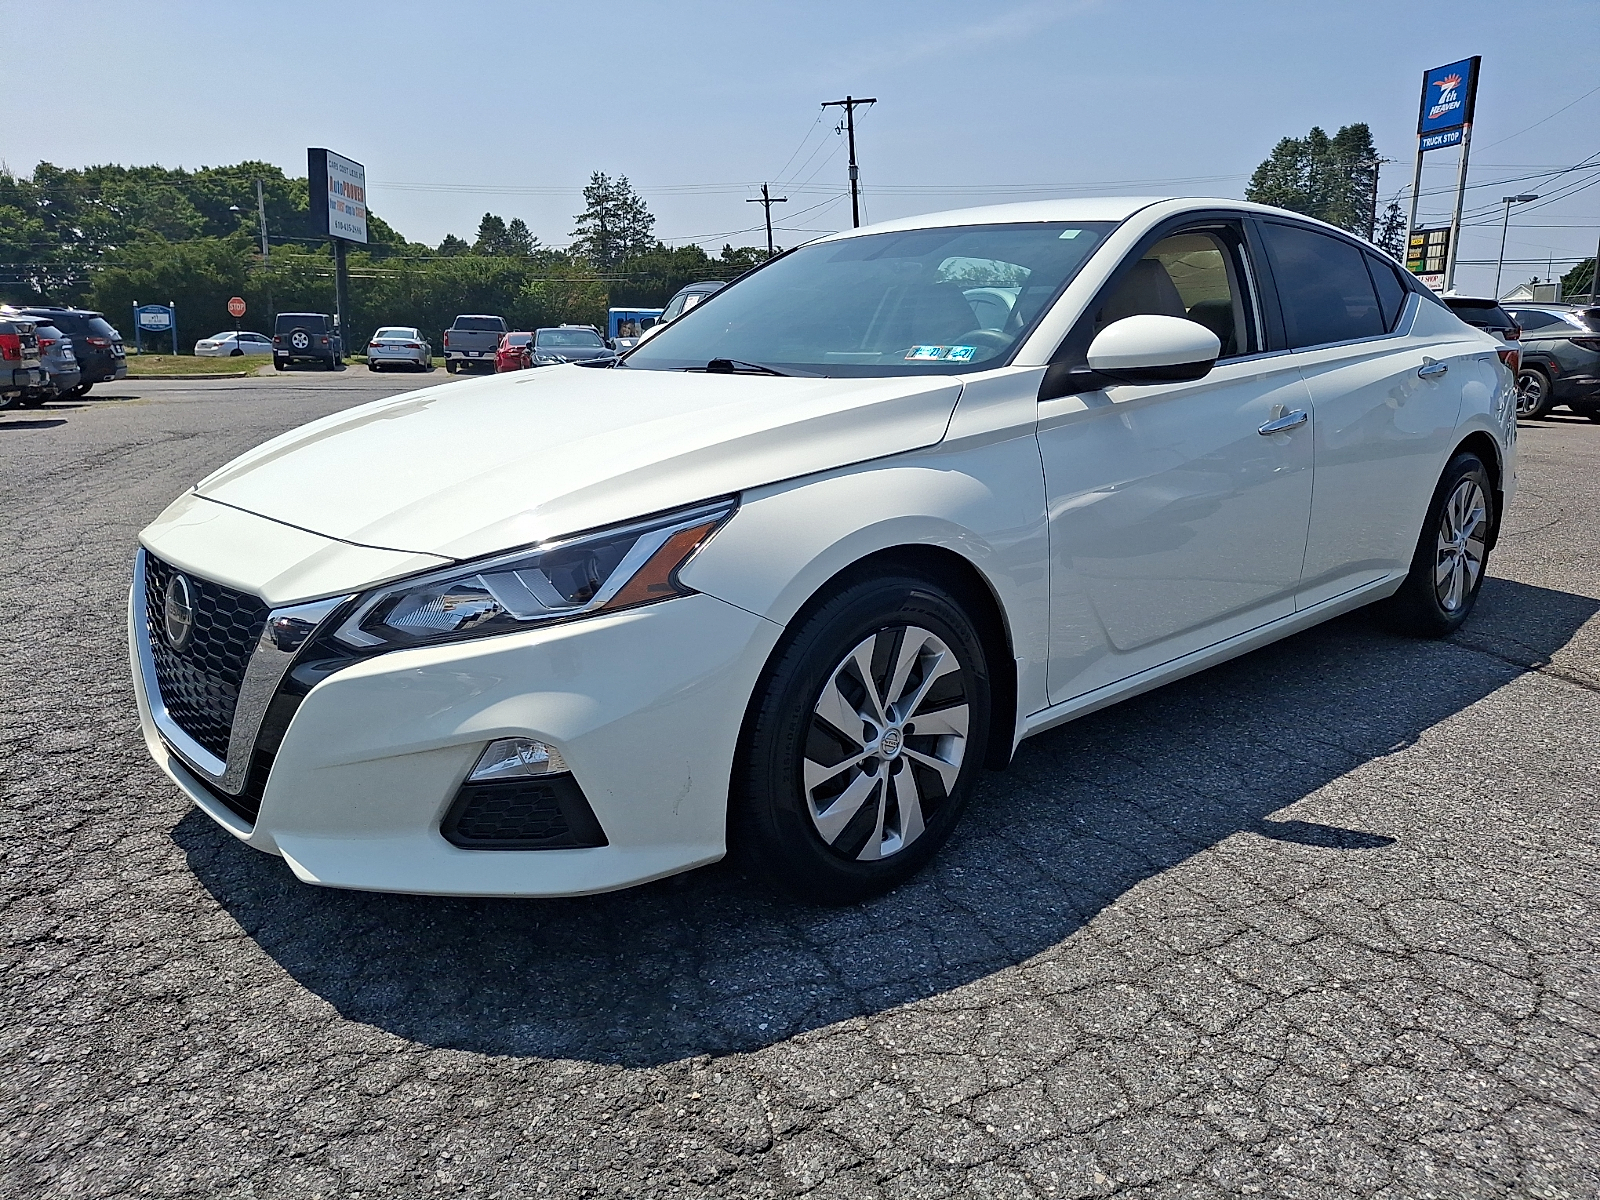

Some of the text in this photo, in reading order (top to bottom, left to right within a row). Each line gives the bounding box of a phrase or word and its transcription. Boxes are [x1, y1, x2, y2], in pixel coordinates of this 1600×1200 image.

[1429, 100, 1462, 116] HEAVEN
[1422, 131, 1460, 148] TRUCK STOP
[339, 164, 349, 175] COST
[229, 302, 245, 311] STOP
